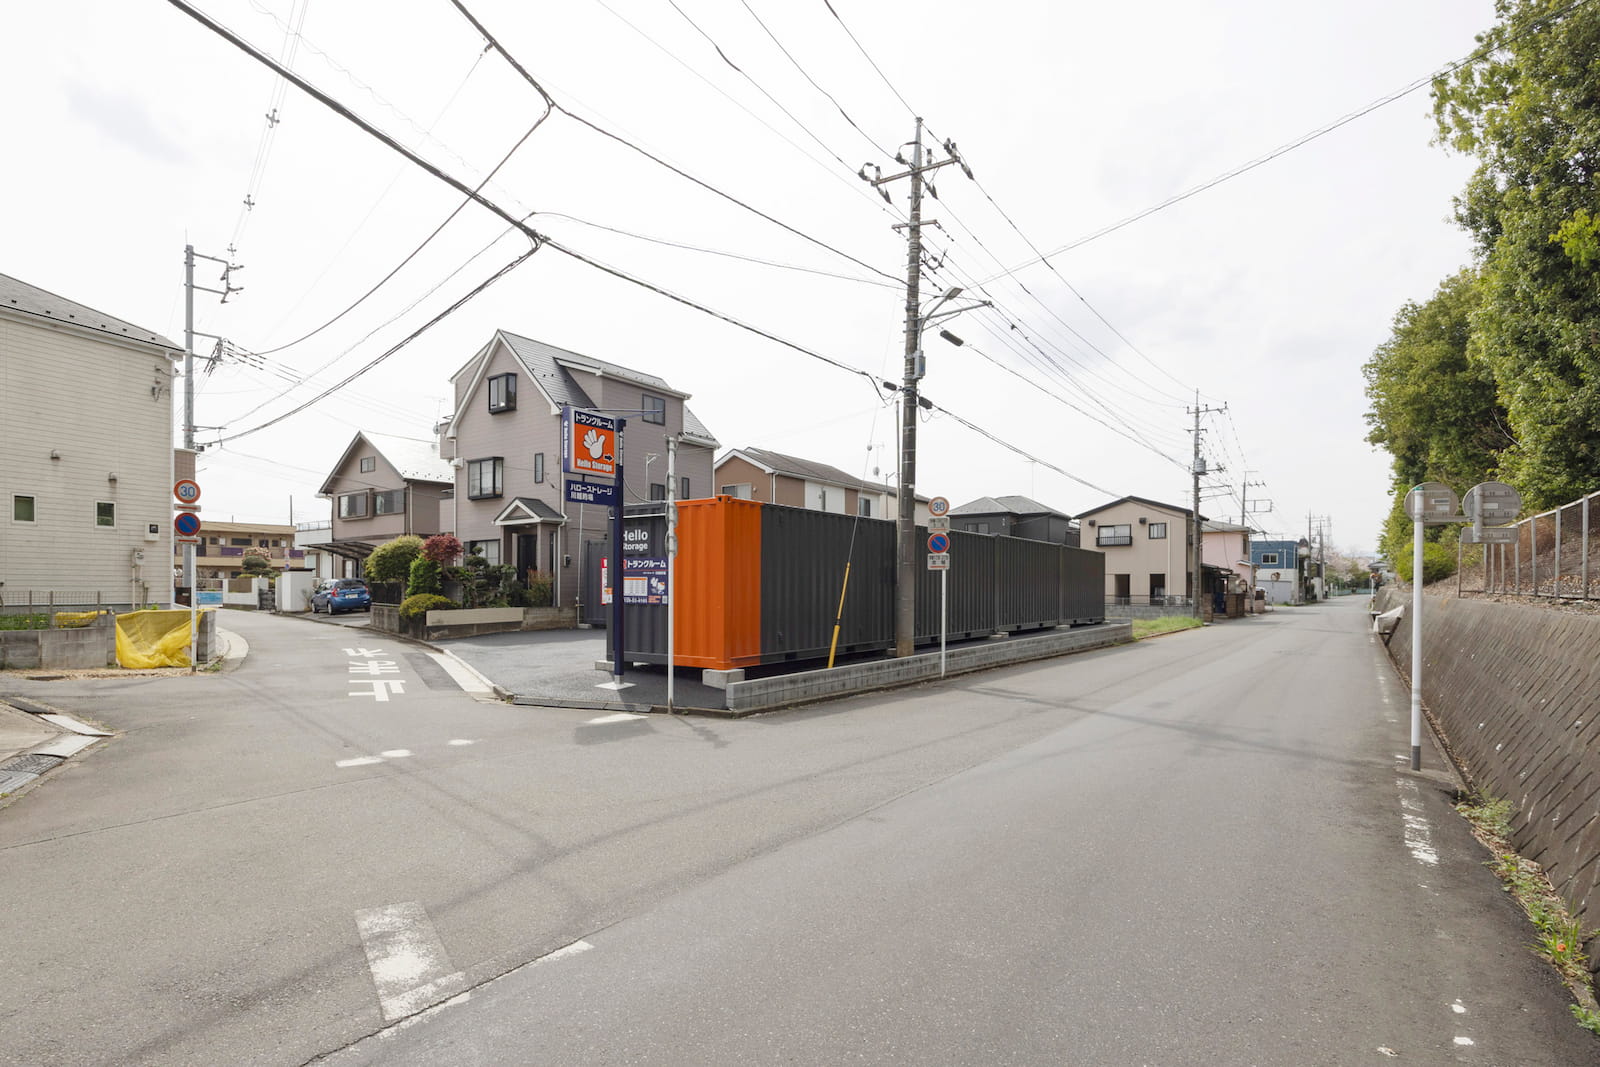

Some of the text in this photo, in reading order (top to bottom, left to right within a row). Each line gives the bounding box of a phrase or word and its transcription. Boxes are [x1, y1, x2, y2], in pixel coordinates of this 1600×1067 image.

[576, 413, 613, 429] トランクルーム
[577, 458, 613, 472] Hello Storage
[180, 485, 196, 498] 30
[570, 483, 613, 496] ハローストレージ
[933, 502, 945, 512] 30
[627, 559, 667, 569] トランクルーム
